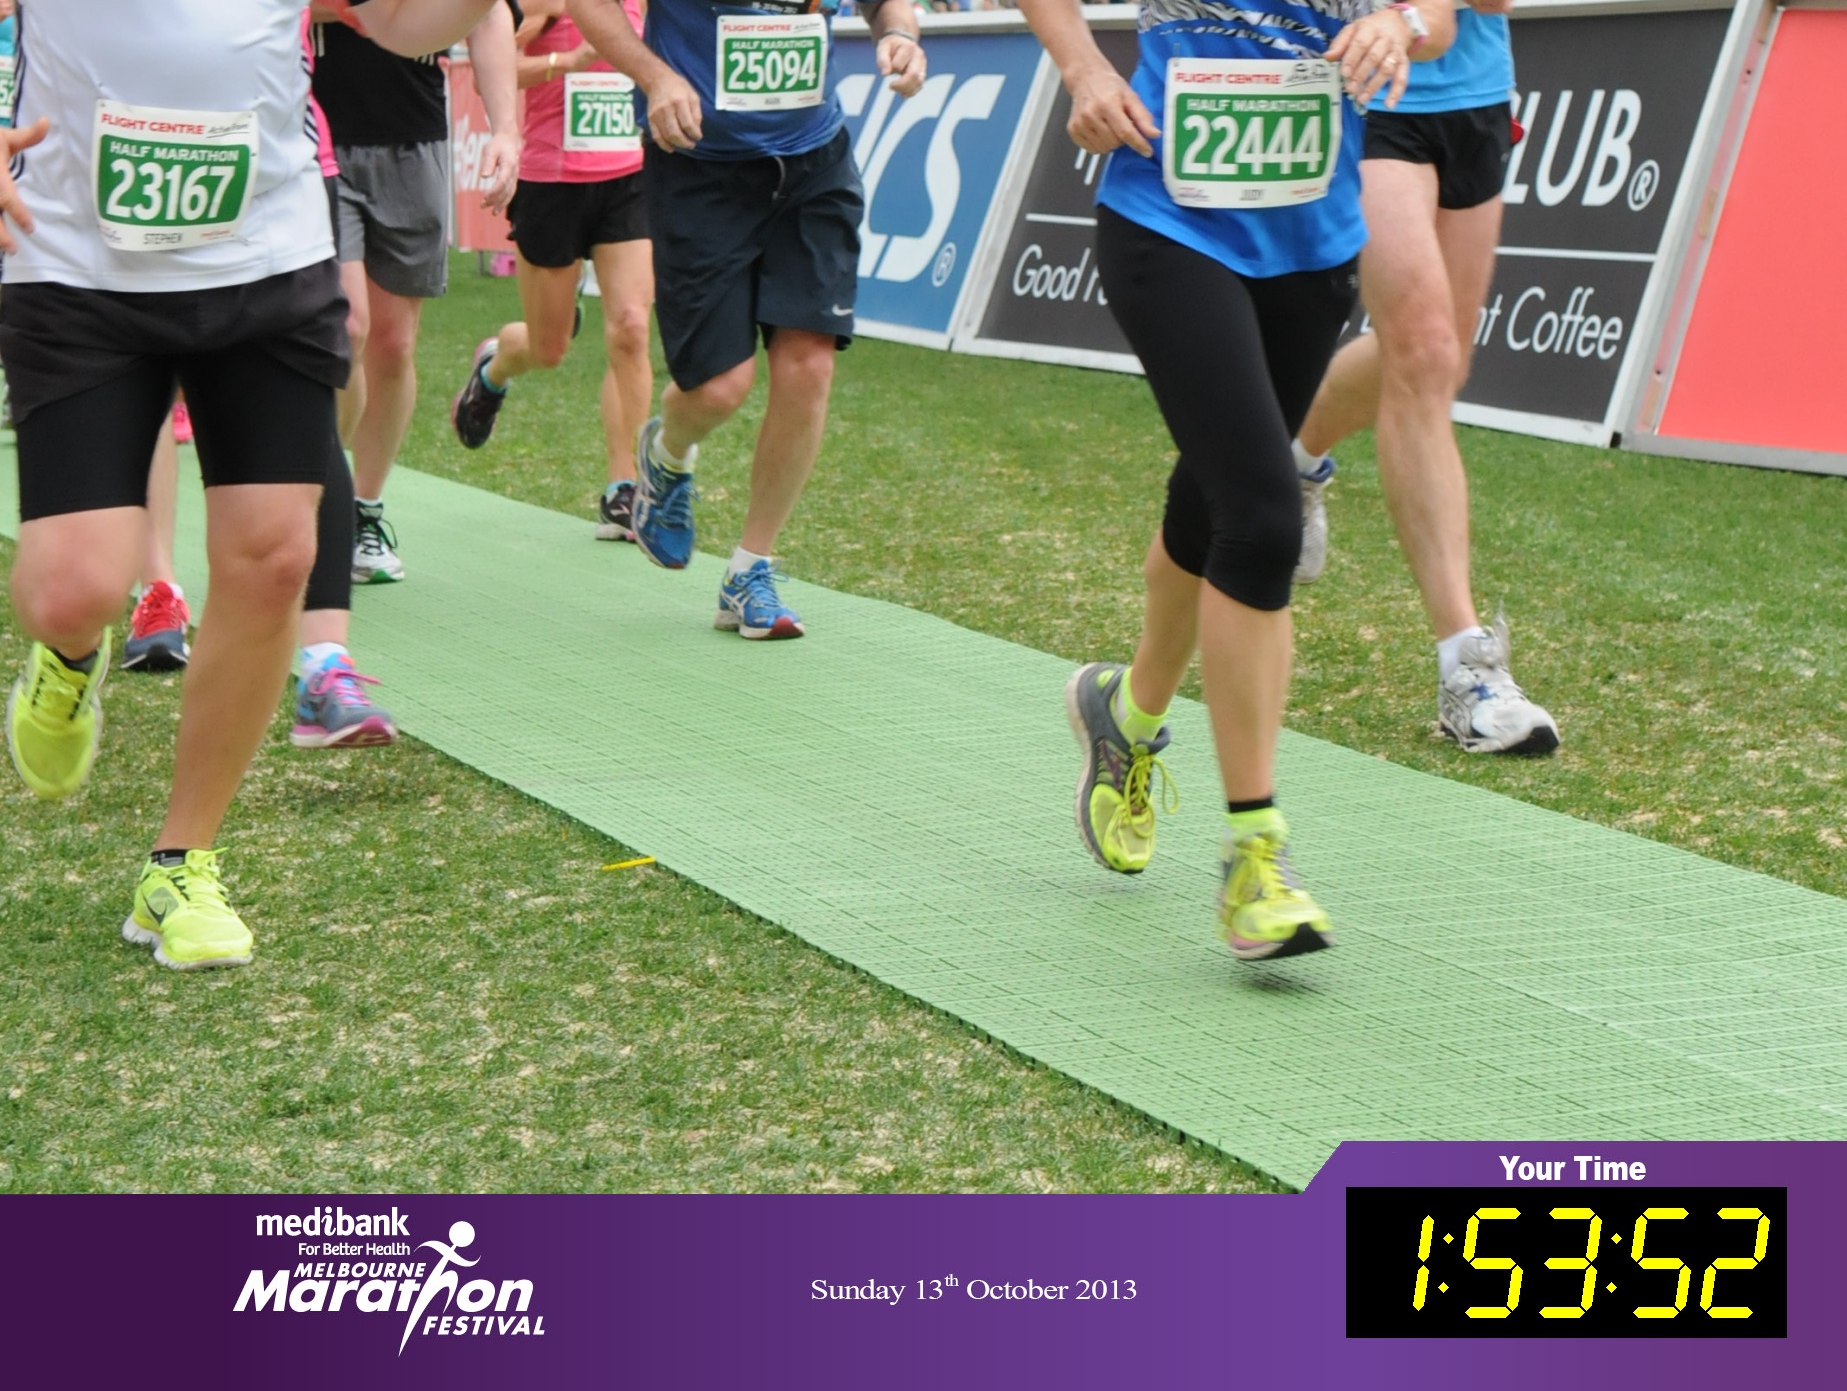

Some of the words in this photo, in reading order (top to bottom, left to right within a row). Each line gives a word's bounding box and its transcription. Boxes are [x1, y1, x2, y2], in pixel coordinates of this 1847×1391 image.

[723, 24, 756, 32] FLIGHT
[757, 24, 791, 32] CENTRE
[732, 40, 760, 50] HALF
[761, 39, 815, 50] MARATHON
[727, 49, 817, 91] 25094
[1174, 72, 1223, 84] FLIGHT
[1225, 73, 1282, 85] CENTRE
[1186, 98, 1230, 112] HALF
[1232, 99, 1321, 113] MARATHON
[102, 113, 148, 132] FLIGHT
[149, 120, 205, 136] CENTRE
[110, 141, 152, 159] HALF
[153, 146, 240, 163] MARATHON
[1180, 114, 1324, 176] 22444
[105, 158, 236, 221] 23167
[1013, 244, 1092, 302] Good
[1506, 286, 1624, 361] Coffee
